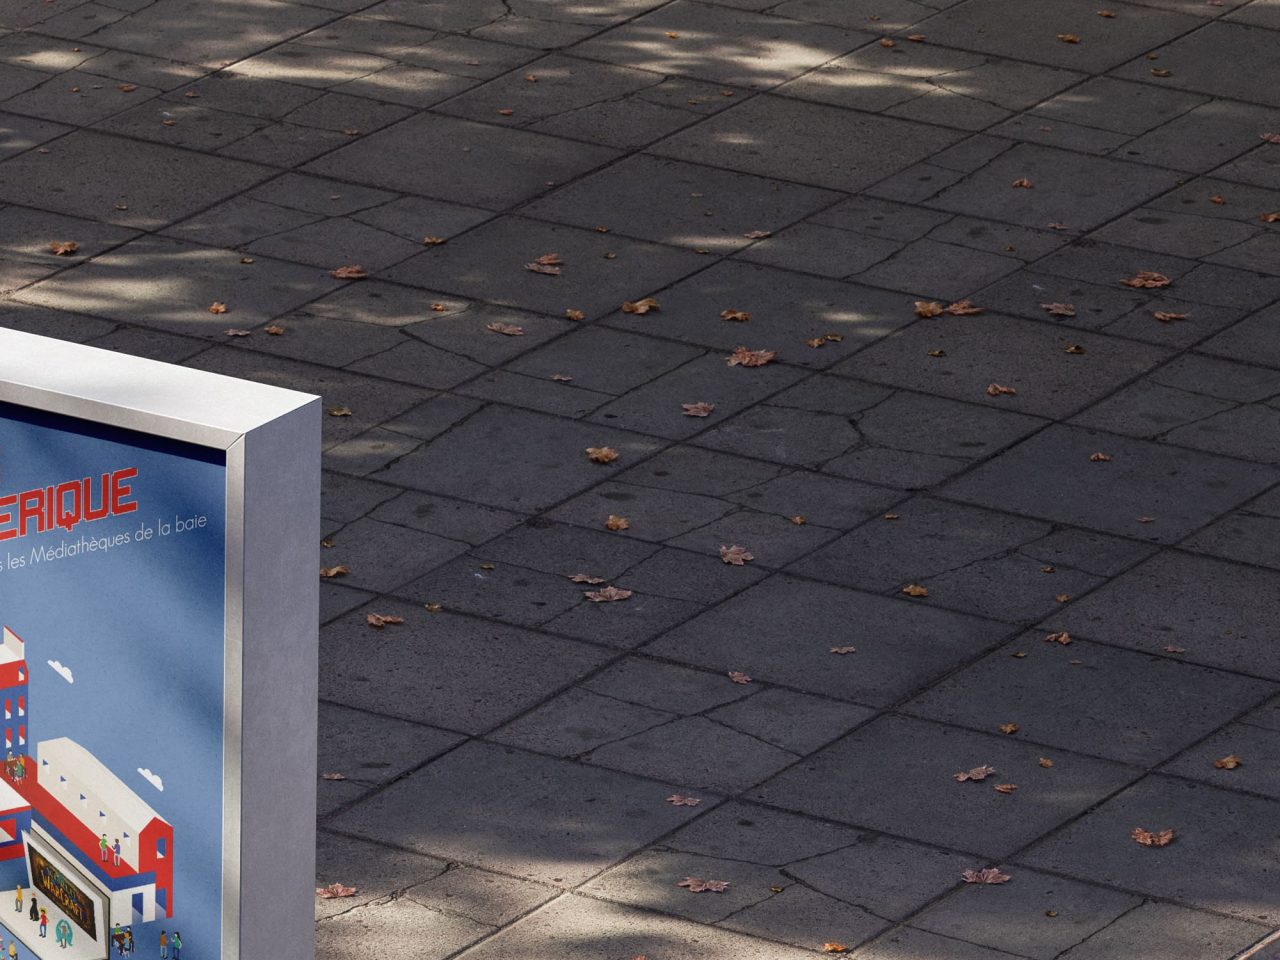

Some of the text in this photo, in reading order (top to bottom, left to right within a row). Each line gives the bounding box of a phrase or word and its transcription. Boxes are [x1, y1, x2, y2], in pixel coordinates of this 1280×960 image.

[7, 554, 25, 570] les
[30, 531, 130, 565] Médiathèques
[134, 527, 153, 542] de
[158, 518, 171, 536] la
[175, 514, 207, 533] baie
